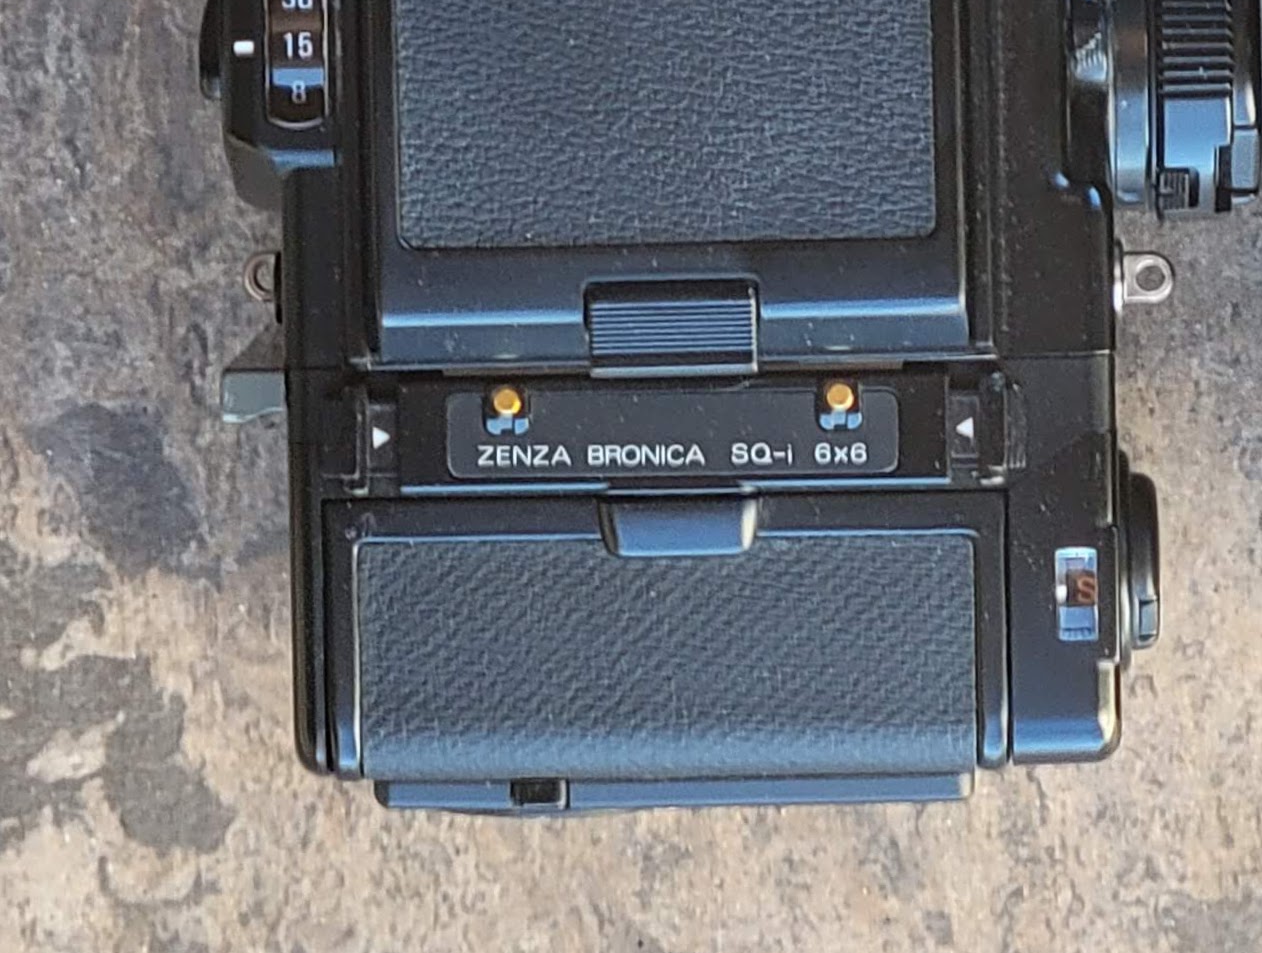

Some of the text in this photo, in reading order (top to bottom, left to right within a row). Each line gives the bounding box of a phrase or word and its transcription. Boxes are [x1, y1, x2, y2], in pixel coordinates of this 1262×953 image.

[282, 31, 314, 60] 15
[291, 79, 307, 105] 8
[477, 443, 868, 467] ZENZA BRONICA SQ-i 6x6
